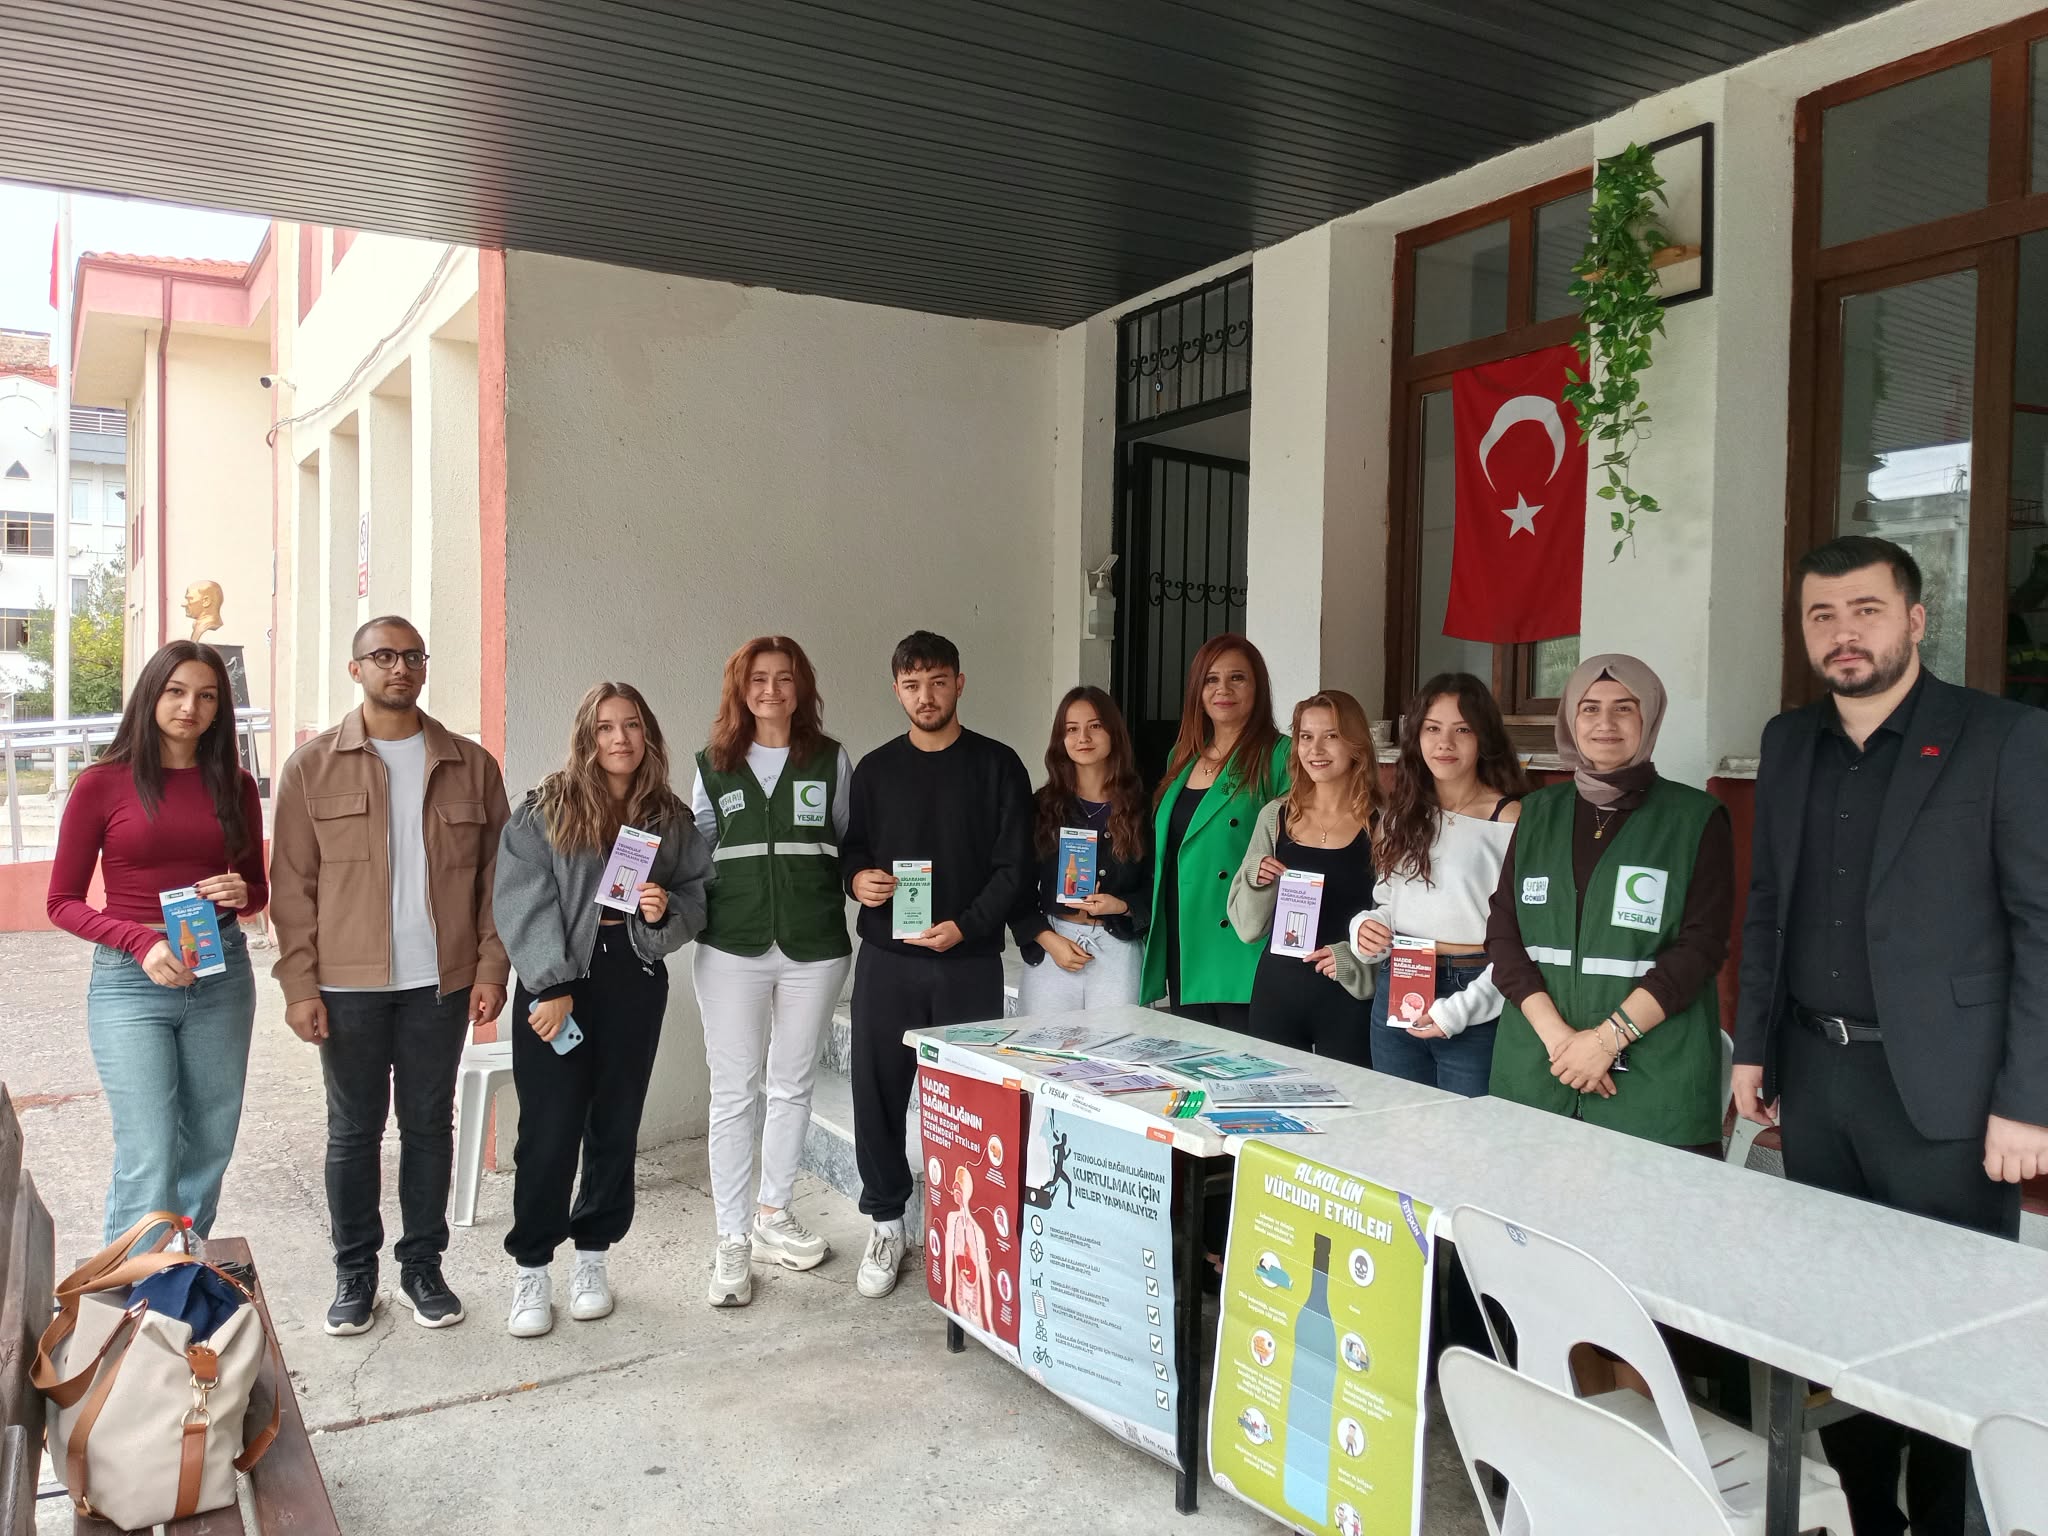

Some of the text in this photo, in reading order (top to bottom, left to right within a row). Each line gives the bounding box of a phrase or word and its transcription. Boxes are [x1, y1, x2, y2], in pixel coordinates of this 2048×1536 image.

[922, 1075, 950, 1099] MADDE
[1072, 1166, 1161, 1204] KURTULMAK İÇİN
[1073, 1152, 1165, 1184] TEKNOLOJİ BAĞIMLILIĞINDAN
[1294, 1162, 1366, 1205] ALKOLÜN
[1074, 1186, 1158, 1221] NELER YAPMALIYIZ?
[1264, 1173, 1321, 1215] VÜCUDA
[1324, 1199, 1393, 1245] ETKİLERİ
[1401, 1200, 1421, 1237] YETİŞKİN
